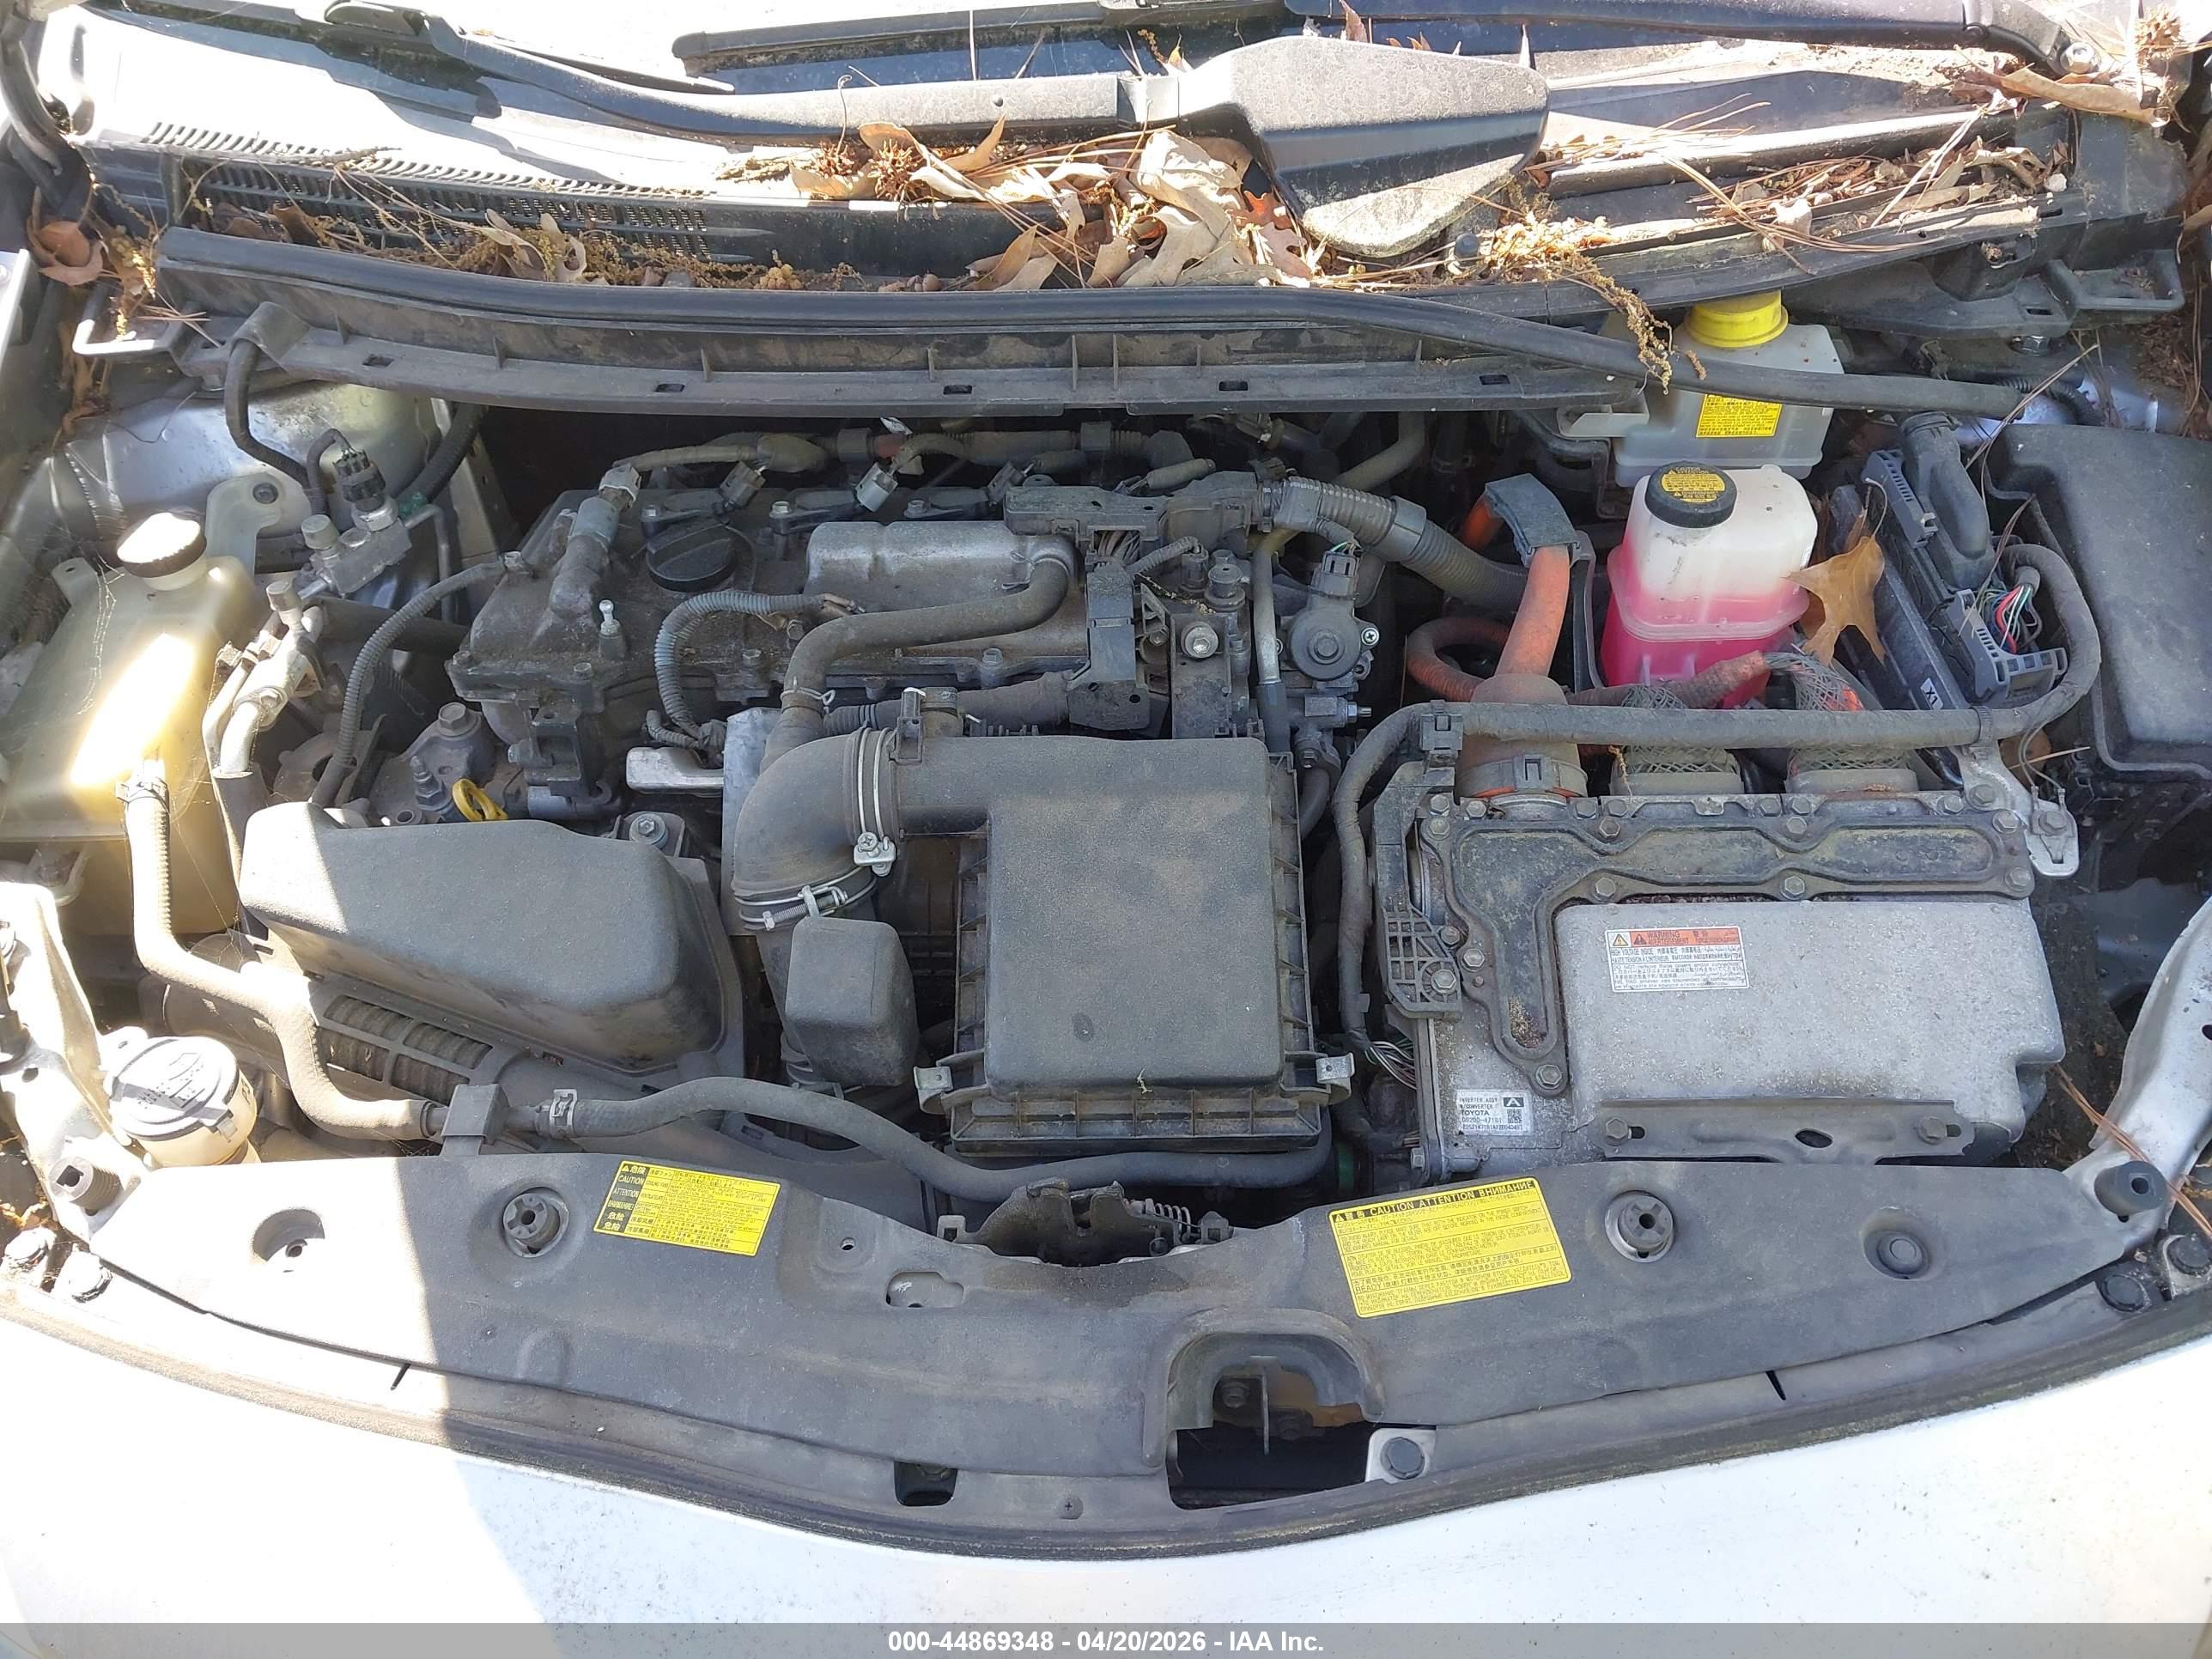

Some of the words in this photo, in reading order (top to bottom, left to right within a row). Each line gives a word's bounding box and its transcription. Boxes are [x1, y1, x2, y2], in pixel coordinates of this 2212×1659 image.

[1925, 686, 1938, 705] X1
[618, 1175, 644, 1185] CAUTION
[612, 1188, 640, 1197] ATTENTION
[1479, 1181, 1535, 1197] ВНИМАНИЕ
[1370, 1202, 1415, 1216] CAUTION
[1419, 1191, 1475, 1208] ATTENTION
